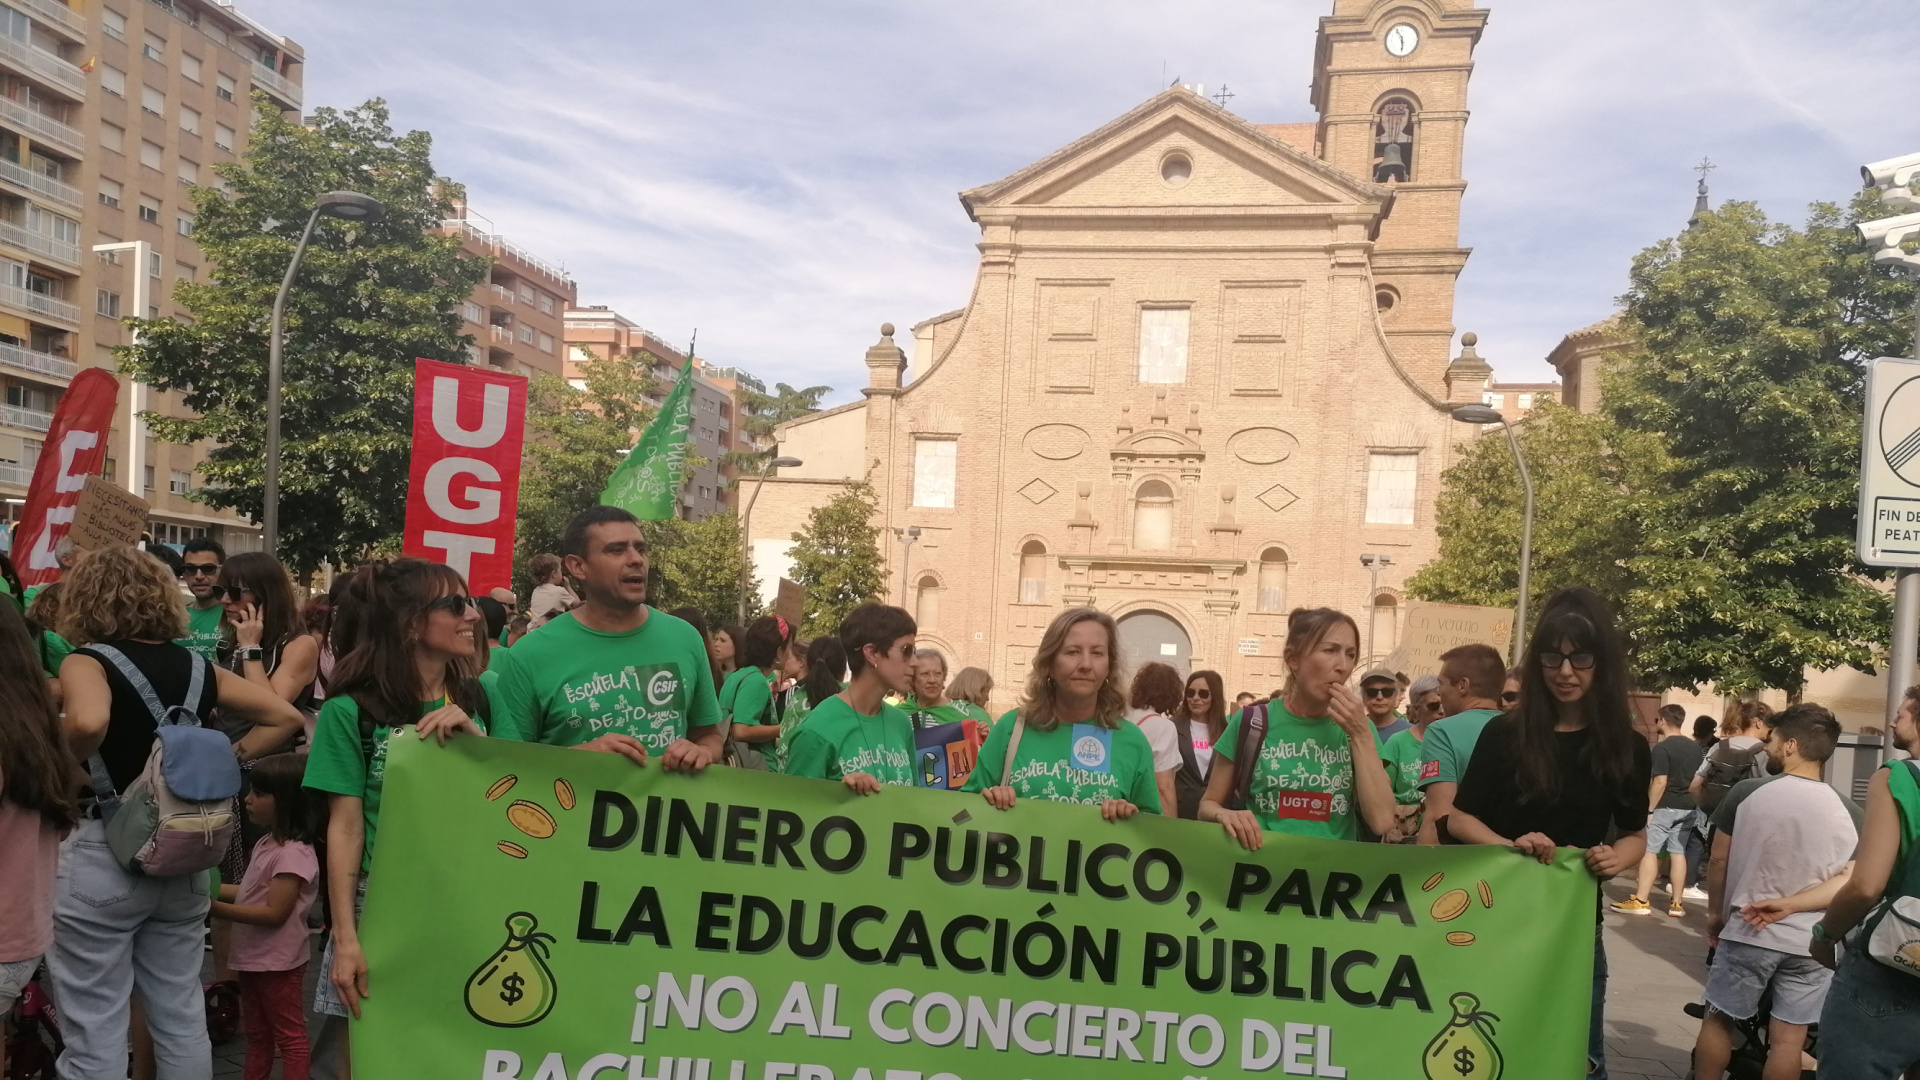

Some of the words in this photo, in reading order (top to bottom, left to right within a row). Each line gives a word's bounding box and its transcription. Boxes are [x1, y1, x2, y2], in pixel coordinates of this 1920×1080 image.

[423, 376, 510, 590] UGT
[87, 481, 149, 521] NECESITAMOS
[1879, 509, 1900, 521] FIN
[88, 514, 136, 545] BIBLIOTECA
[1438, 617, 1479, 634] verano
[1425, 634, 1446, 645] nos
[101, 644, 166, 719] MARTIN
[566, 671, 630, 703] ESCUELA
[653, 680, 678, 694] CSIF
[589, 713, 613, 732] DE
[840, 748, 885, 775] ESCUELA
[1077, 751, 1101, 760] ANPE
[1262, 742, 1310, 760] SCUELA
[1314, 745, 1351, 765] PÚBLIC
[1267, 774, 1289, 788] DE
[1297, 774, 1351, 791] TOD@S
[1283, 797, 1310, 808] UGT
[587, 789, 867, 875] DINERO
[888, 808, 1202, 915] PÚBLICO,
[1226, 862, 1416, 925] PARA
[576, 880, 672, 948] LA
[695, 891, 1120, 985] EDUCACIÓN
[1141, 917, 1433, 1013] PÚBLICA
[630, 972, 759, 1045] ¡NO
[769, 981, 851, 1043] AL
[868, 988, 1227, 1070] CONCIERTO
[1240, 1017, 1347, 1079] DEL
